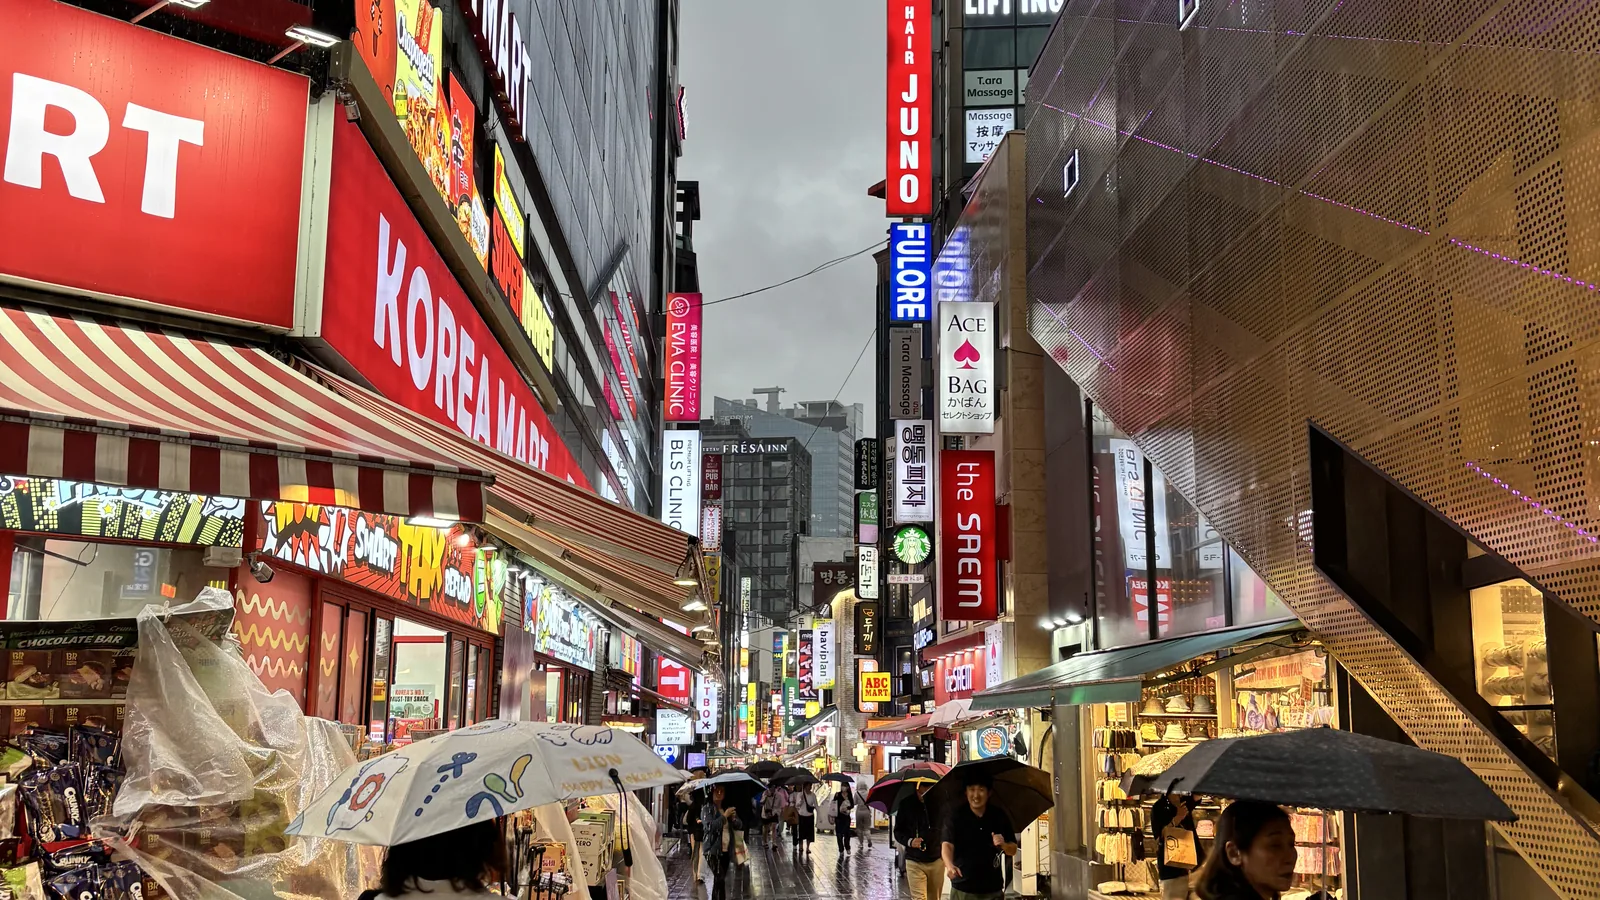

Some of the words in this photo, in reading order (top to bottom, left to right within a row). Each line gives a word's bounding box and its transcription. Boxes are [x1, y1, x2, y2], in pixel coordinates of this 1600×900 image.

[905, 6, 914, 64] HAIR
[967, 89, 1013, 98] Massage
[977, 77, 1002, 85] T.ara
[968, 112, 1012, 121] Massage
[976, 125, 1004, 137] 按摩
[4, 72, 205, 219] RT
[900, 74, 918, 203] JUNO
[492, 207, 523, 318] SUPER
[896, 225, 926, 318] FULORE
[522, 267, 554, 374] MARKET
[948, 315, 986, 332] ACE
[374, 213, 491, 450] KOREA
[496, 378, 549, 472] MART
[671, 323, 685, 357] EVIA
[901, 336, 912, 367] T.ara
[670, 362, 685, 415] CLINIC
[900, 366, 912, 415] Massage
[948, 397, 986, 407] かばん
[949, 376, 987, 394] BAG
[942, 411, 992, 420] セレクトショップ
[671, 440, 683, 470] BLS
[768, 444, 788, 452] INN
[902, 425, 926, 507] 명동피자
[957, 463, 980, 500] the
[670, 476, 683, 530] CLINIC
[355, 516, 397, 573] SMART
[398, 517, 447, 599] TAX
[957, 513, 981, 608] SAEM
[445, 566, 471, 604] REFUND
[861, 551, 872, 589] 명돈가
[17, 636, 92, 648] CHOCOLATE
[94, 635, 123, 644] BAR
[820, 631, 829, 677] baviplan
[865, 678, 888, 688] ABC
[14, 708, 26, 716] BR
[67, 708, 78, 716] BR
[571, 754, 622, 772] LION
[64, 787, 81, 825] CRUNKY
[51, 855, 92, 868] CRUNKY
